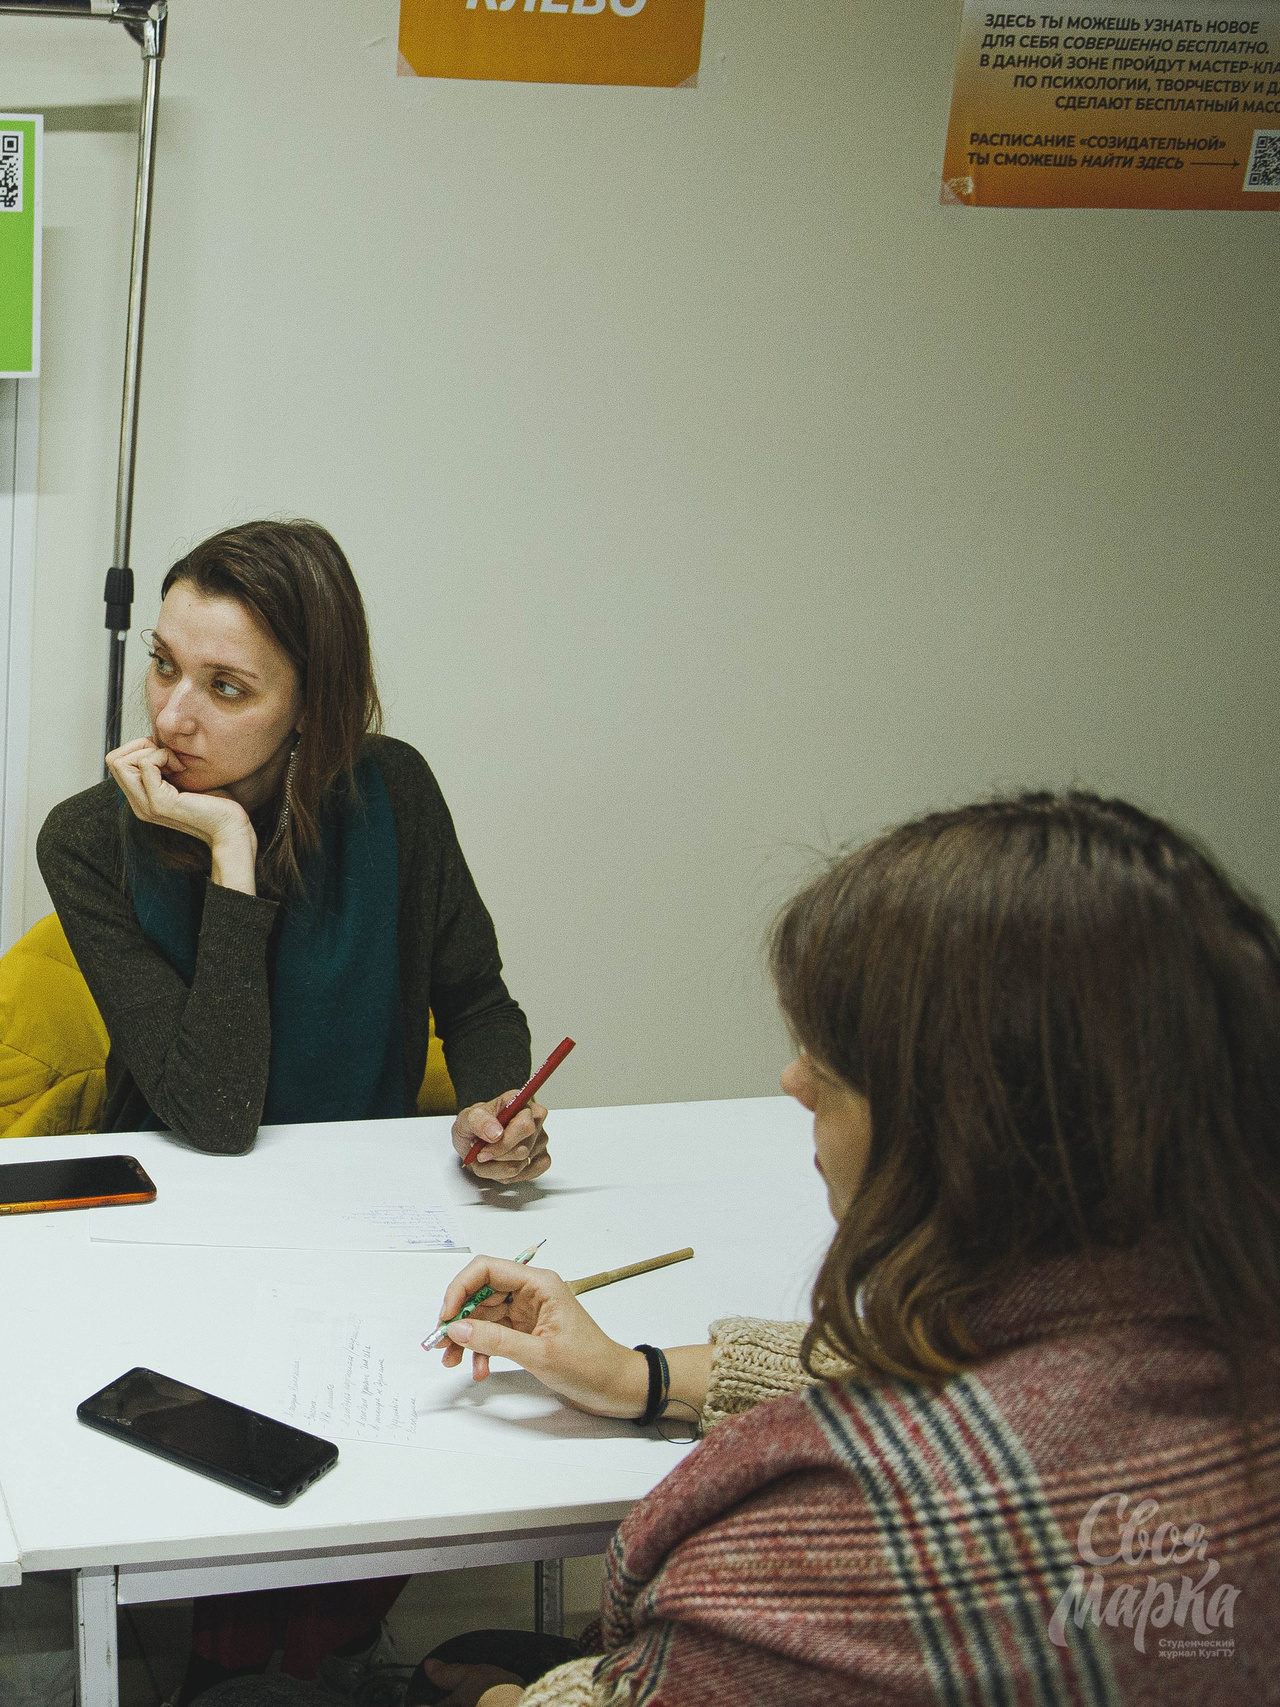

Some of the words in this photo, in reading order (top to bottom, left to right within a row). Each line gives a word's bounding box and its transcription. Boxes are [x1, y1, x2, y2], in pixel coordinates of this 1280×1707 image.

[984, 13, 1036, 30] ЗДЕСЬ
[1040, 15, 1063, 29] ТЫ
[1067, 16, 1140, 31] МОЖЕШЬ
[1143, 18, 1202, 34] УЗНАТЬ
[1206, 20, 1260, 35] НОВОЕ
[981, 34, 1016, 49] ДЛЯ
[1020, 35, 1059, 49] СЕБЯ
[1063, 36, 1172, 53] СОВЕРШЕННО
[1176, 40, 1270, 54] БЕСПЛАТНО.
[980, 54, 990, 67] В
[992, 53, 1063, 69] ДАННОЙ
[1066, 56, 1109, 70] ЗОНЕ
[1112, 55, 1186, 74] ПРОЙДУТ
[1013, 75, 1037, 88] ПО
[1041, 76, 1151, 92] ПСИХОЛОГИИ,
[1156, 79, 1251, 93] ТВОРЧЕСТВУ
[1253, 82, 1263, 93] И
[1266, 82, 1280, 96] Д
[1055, 96, 1132, 111] СДЕЛАЮТ
[1135, 97, 1239, 113] БЕСПЛАТНЫЙ
[970, 133, 1076, 149] РАСПИСАНИЕ
[1079, 135, 1226, 152] «СОЗИДАТЕЛЬНОЙ»
[968, 152, 990, 166] ТЫ
[993, 153, 1077, 168] СМОЖЕШЬ
[1081, 153, 1134, 169] НАЙТИ
[1137, 156, 1184, 171] ЗДЕСЬ
